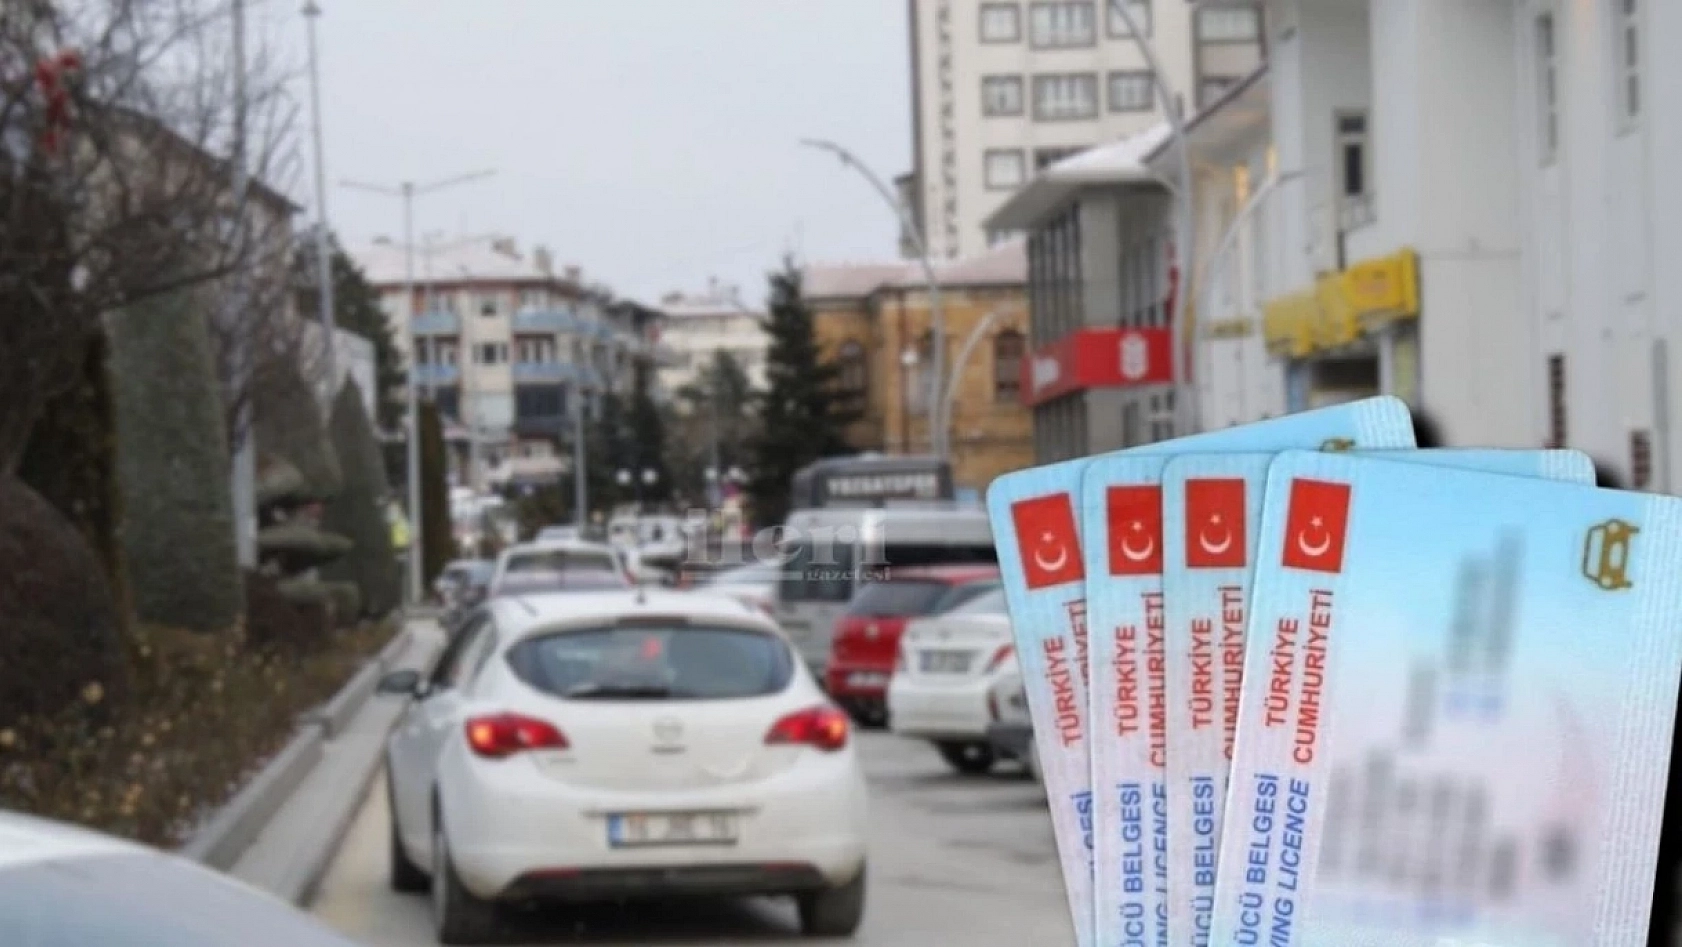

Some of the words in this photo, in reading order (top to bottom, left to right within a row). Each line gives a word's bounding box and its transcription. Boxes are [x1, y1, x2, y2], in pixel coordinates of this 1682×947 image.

[1043, 635, 1083, 747] TÜRKİYE
[1113, 624, 1139, 737] TÜRKİYE
[1187, 617, 1213, 730] TÜRKİYE
[1263, 616, 1299, 727] TÜRKİYE
[1292, 588, 1335, 764] CUMHURİYETİ
[1115, 783, 1143, 893] BELGESİ
[1188, 776, 1215, 886] BELGESİ
[1246, 773, 1279, 884] BELGESİ
[1277, 778, 1310, 892] LICENCE
